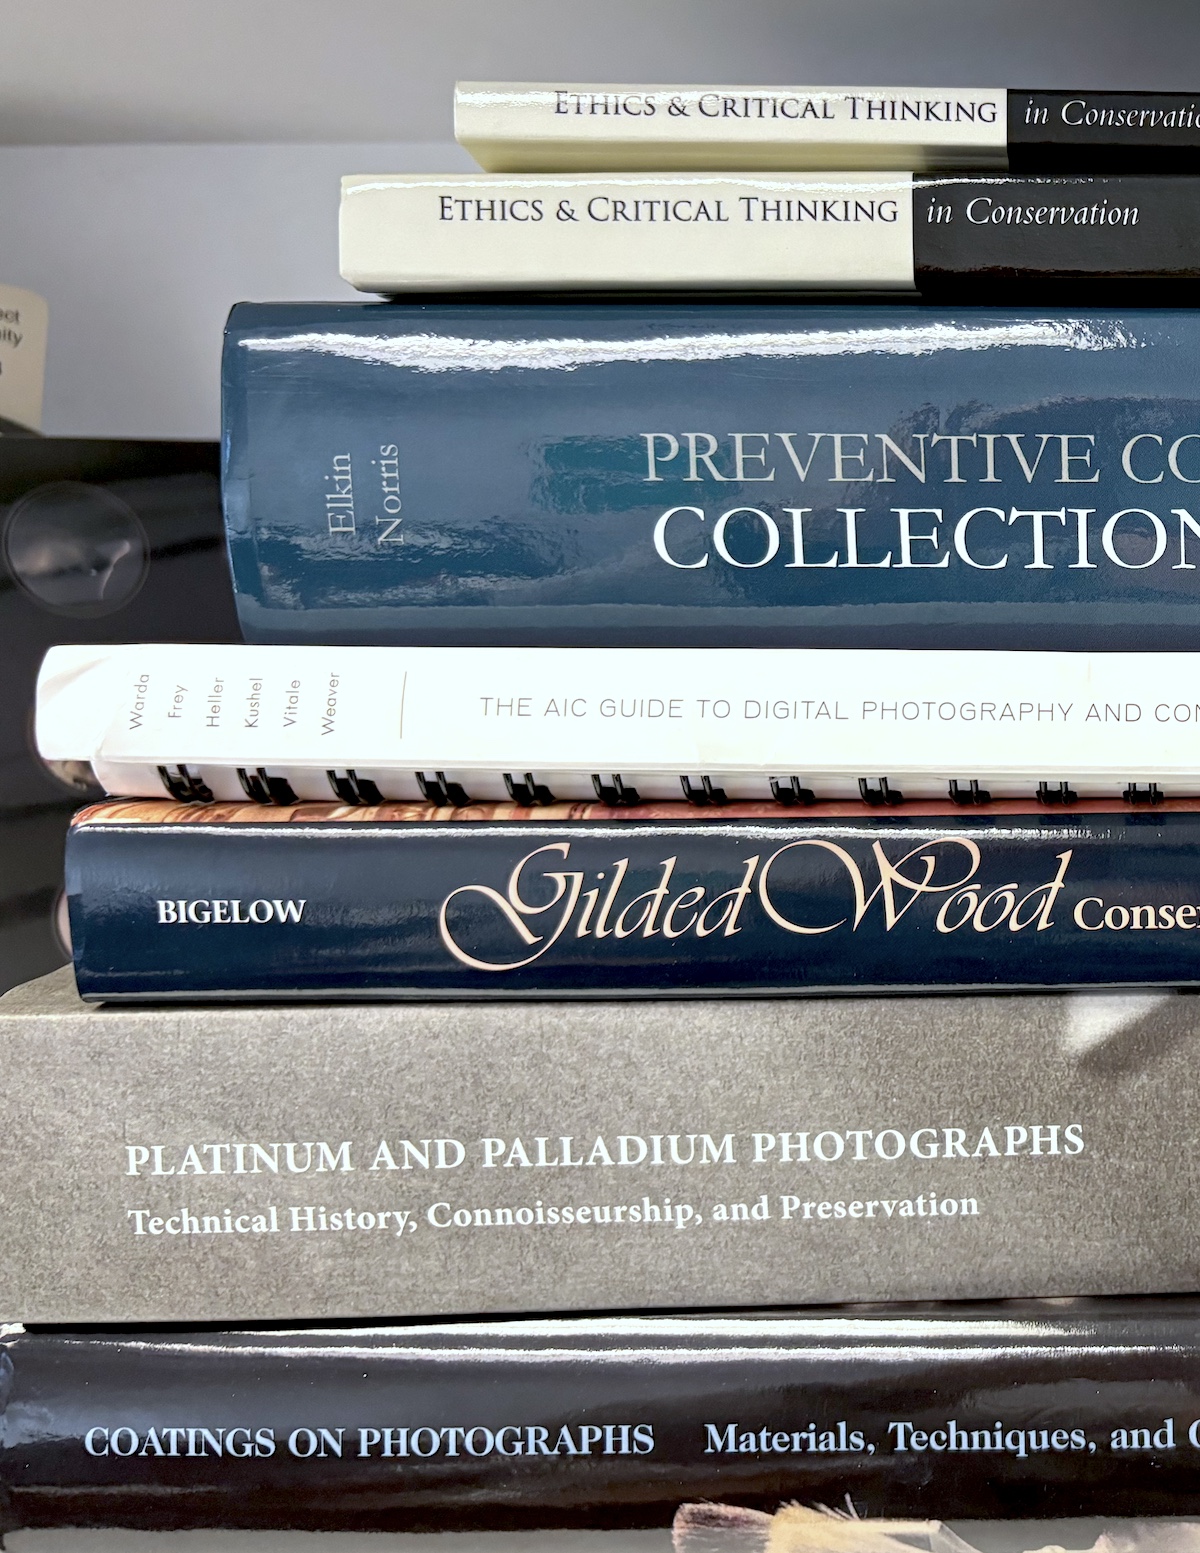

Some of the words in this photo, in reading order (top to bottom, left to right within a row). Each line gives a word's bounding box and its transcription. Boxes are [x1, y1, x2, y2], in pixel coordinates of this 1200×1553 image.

[554, 90, 656, 117] ETHICS
[667, 95, 691, 117] &
[698, 93, 836, 121] CRITICAL
[848, 96, 998, 124] THINKING
[1024, 100, 1050, 126] in
[438, 195, 545, 223] ETHICS
[555, 195, 581, 223] &
[586, 195, 730, 224] CRITICAL
[740, 195, 899, 224] THINKING
[926, 200, 954, 226] in
[965, 197, 1141, 229] Conservation
[639, 432, 1099, 484] PREVENTIVE
[324, 452, 355, 537] Elkin
[371, 444, 404, 546] Norris
[128, 673, 150, 730] Warda
[167, 684, 189, 719] Frey
[205, 676, 225, 728] Heller
[243, 677, 264, 728] Kushel
[282, 678, 301, 728] Vitale
[320, 671, 341, 736] Weaver
[479, 696, 533, 718] THE
[543, 697, 588, 719] AIC
[598, 697, 684, 719] GUIDE
[695, 698, 732, 719] TO
[744, 699, 850, 721] DIGITAL
[862, 700, 1075, 723] PHOTOGRAPHY
[1085, 702, 1143, 724] AND
[156, 898, 308, 926] BIGELOW
[439, 841, 760, 971] Gilded
[757, 836, 1073, 936] Wood
[124, 1139, 356, 1180] PLATINUM
[367, 1136, 468, 1176] AND
[480, 1131, 739, 1172] PALLADIUM
[751, 1122, 1087, 1165] PHOTOGRAPHS
[127, 1204, 280, 1238] Technical
[288, 1201, 419, 1239] History,
[425, 1195, 704, 1233] Connoisseurship,
[711, 1194, 772, 1225] and
[779, 1189, 981, 1223] Preservation
[84, 1425, 276, 1458] COATINGS
[287, 1426, 345, 1458] ON
[356, 1422, 656, 1458] PHOTOGRAPHS
[703, 1421, 877, 1456] Materials,
[888, 1419, 1097, 1458] Techniques,
[1109, 1417, 1176, 1451] and
